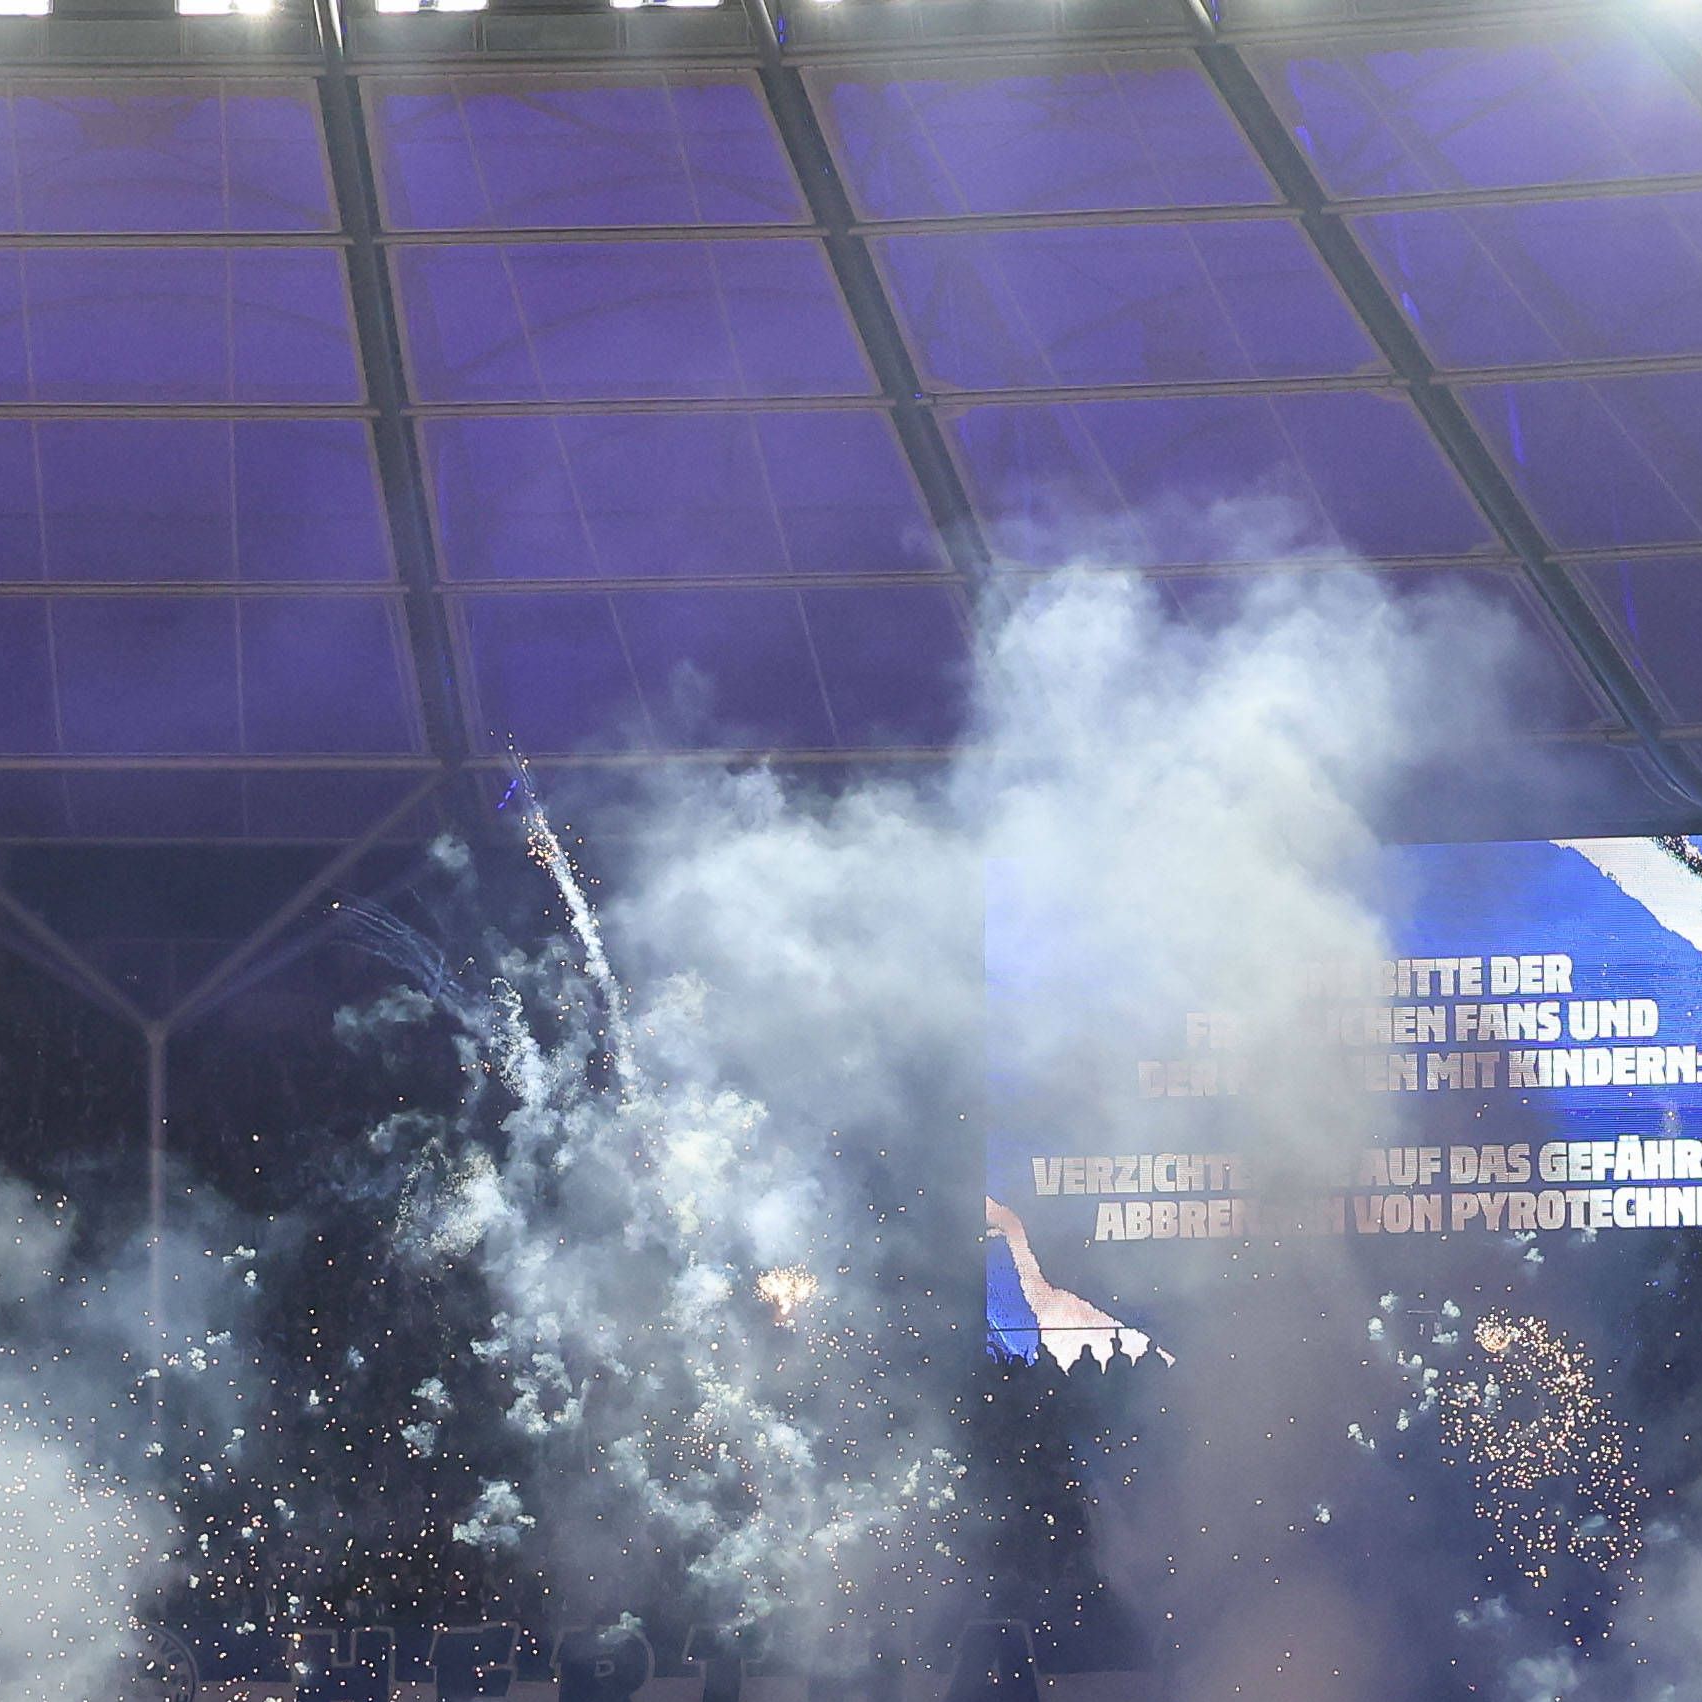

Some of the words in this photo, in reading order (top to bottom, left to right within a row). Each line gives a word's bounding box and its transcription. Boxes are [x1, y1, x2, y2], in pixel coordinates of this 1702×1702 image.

[1378, 956, 1482, 998] BITTE
[1490, 952, 1573, 994] DER
[1455, 999, 1562, 1042] FANS
[1568, 998, 1659, 1040] UND
[1426, 1051, 1500, 1091] MIT
[1032, 1154, 1279, 1197] VERZICHTE
[1360, 1145, 1441, 1188] AUF
[1450, 1143, 1531, 1185] DAS
[1354, 1192, 1442, 1234] VON
